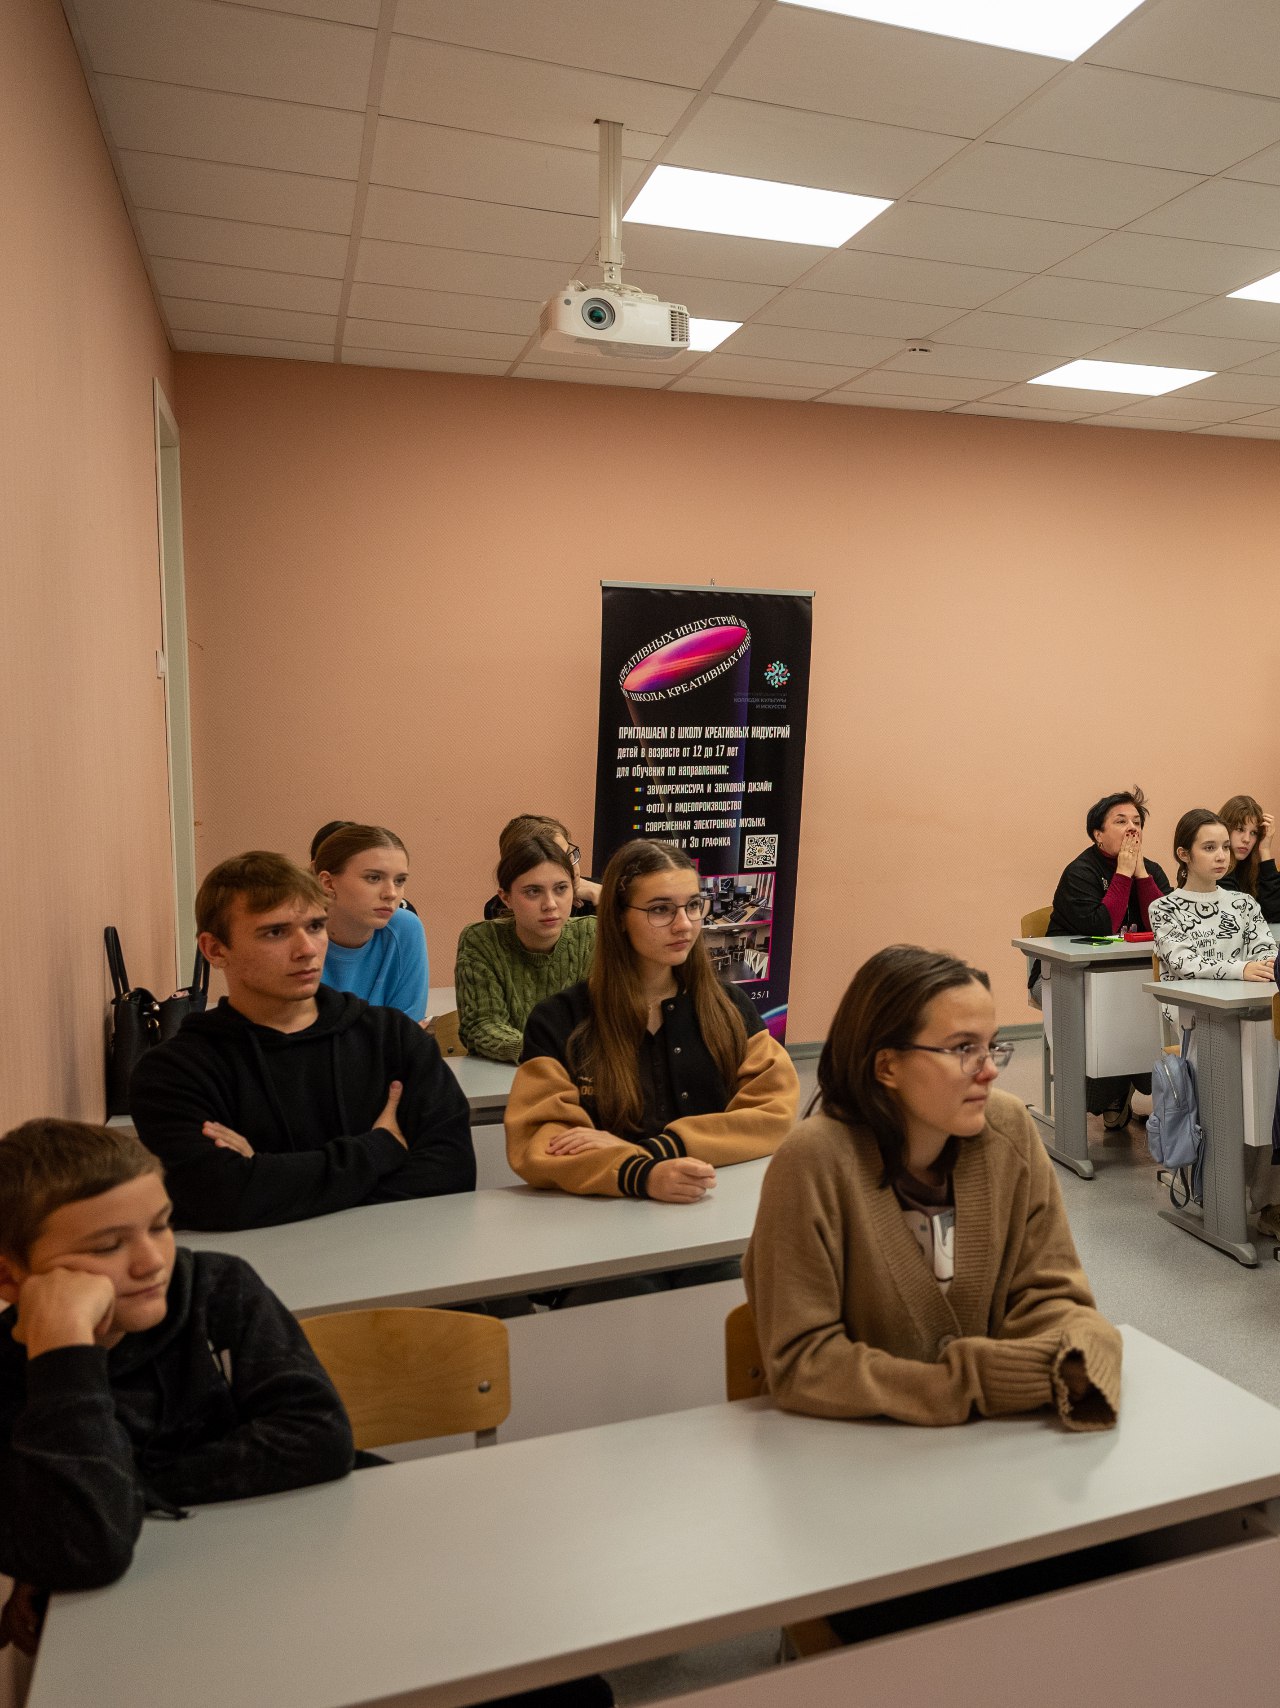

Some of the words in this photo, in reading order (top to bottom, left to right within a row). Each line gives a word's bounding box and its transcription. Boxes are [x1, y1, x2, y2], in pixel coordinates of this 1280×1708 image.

[630, 691, 666, 702] ШКОЛА
[667, 652, 738, 697] КРЕАТИВНЫХ
[618, 726, 668, 739] ПРИГЛАШАЕМ
[670, 726, 676, 739] В
[677, 726, 703, 739] ШКОЛУ
[704, 726, 749, 739] КРЕАТИВНЫХ
[751, 724, 791, 740] ИНДУСТРИЙ
[617, 745, 638, 760] детей
[640, 747, 646, 758] в
[648, 747, 680, 760] возрасте
[682, 747, 690, 758] от
[692, 745, 702, 757] 12
[704, 746, 713, 759] до
[715, 745, 725, 757] 17
[726, 747, 739, 757] лет
[616, 766, 629, 778] для
[632, 764, 665, 778] обучения
[667, 766, 676, 777] по
[678, 765, 730, 777] направлениям:
[647, 783, 705, 795] ЗВУКОРЕЖИССУРА
[706, 783, 712, 793] И
[714, 781, 746, 793] ЗВУКОВОЙ
[748, 781, 773, 793] ДИЗАЙН
[646, 802, 665, 814] ФОТО
[667, 802, 672, 813] И
[675, 800, 742, 813] ВИДЕОПРОИЗВОДСТВО
[645, 820, 691, 832] СОВРЕМЕННАЯ
[693, 818, 737, 831] ЭЛЕКТРОННАЯ
[739, 817, 766, 828] МУЗЫКА
[681, 838, 687, 849] И
[701, 836, 731, 848] ГРАФИКА
